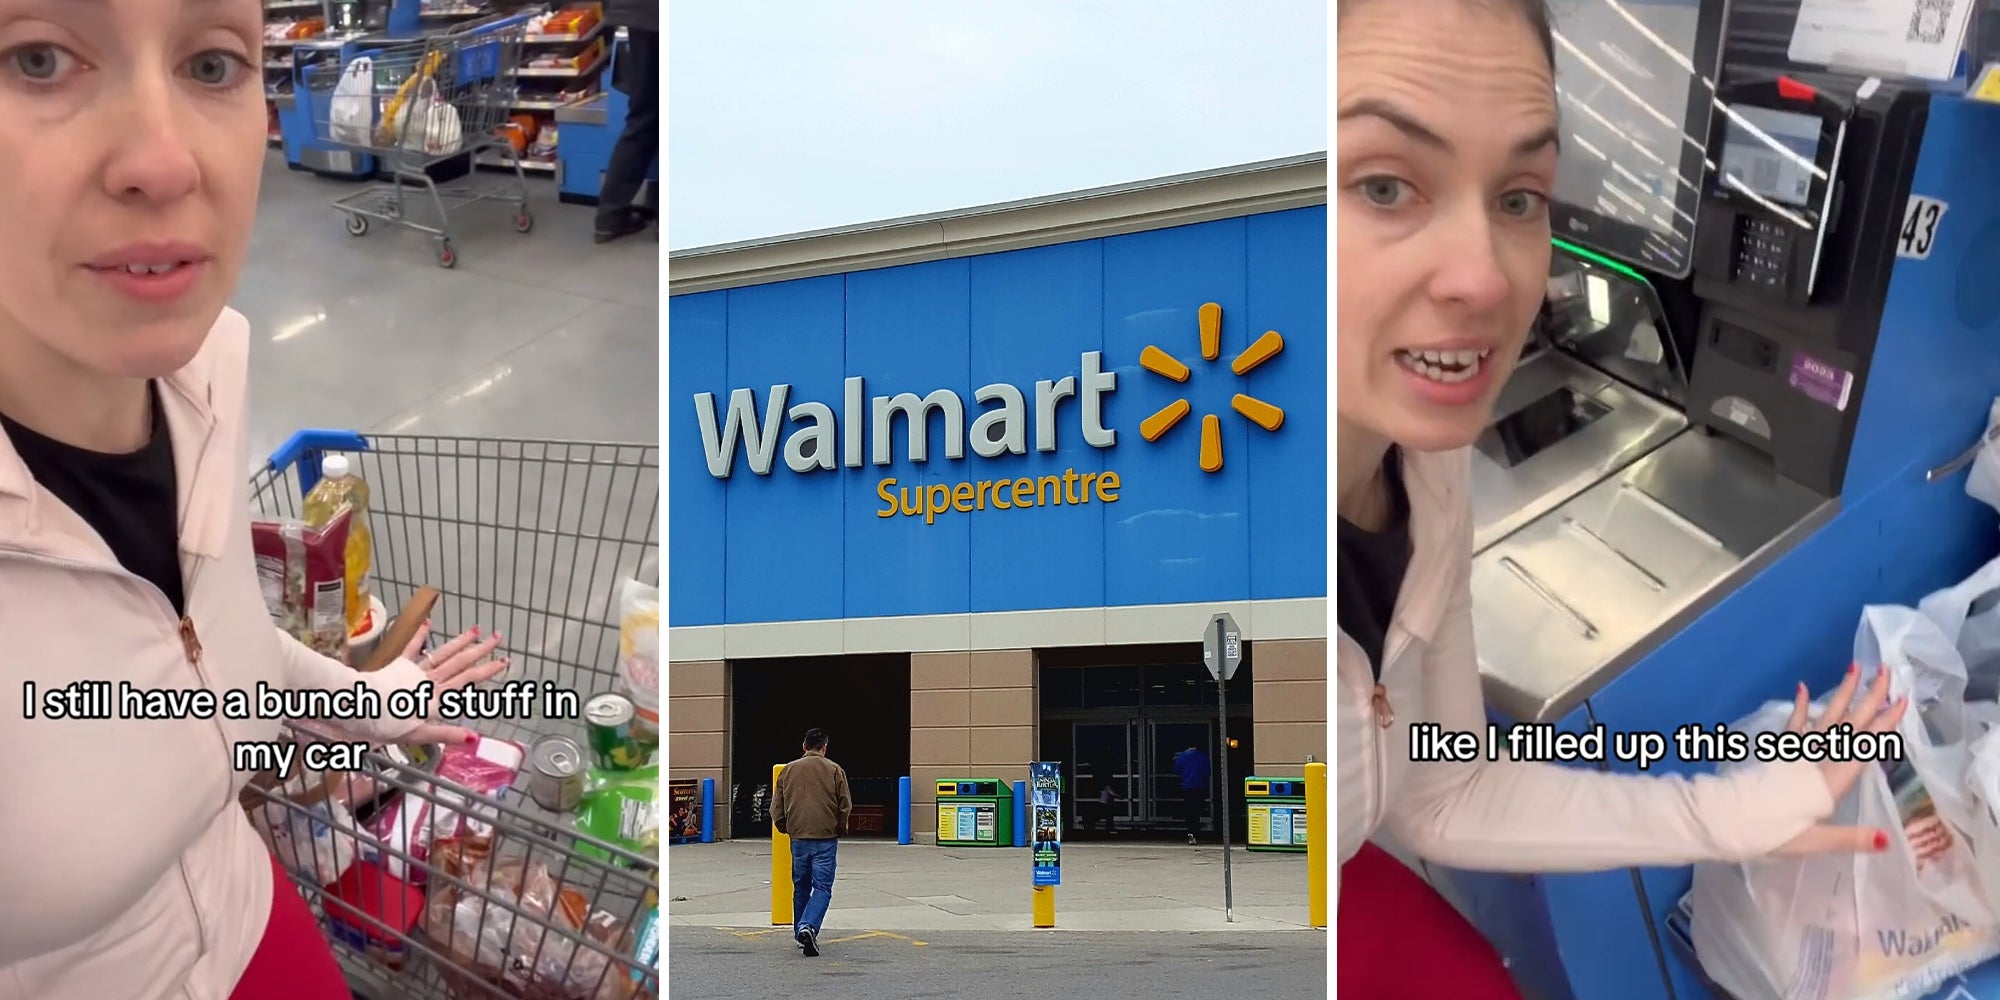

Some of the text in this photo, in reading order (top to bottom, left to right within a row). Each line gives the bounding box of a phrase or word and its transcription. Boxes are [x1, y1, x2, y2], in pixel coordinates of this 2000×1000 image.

[1901, 199, 1941, 255] 43
[693, 350, 1117, 479] Walmart
[876, 467, 1121, 525] Supercentre
